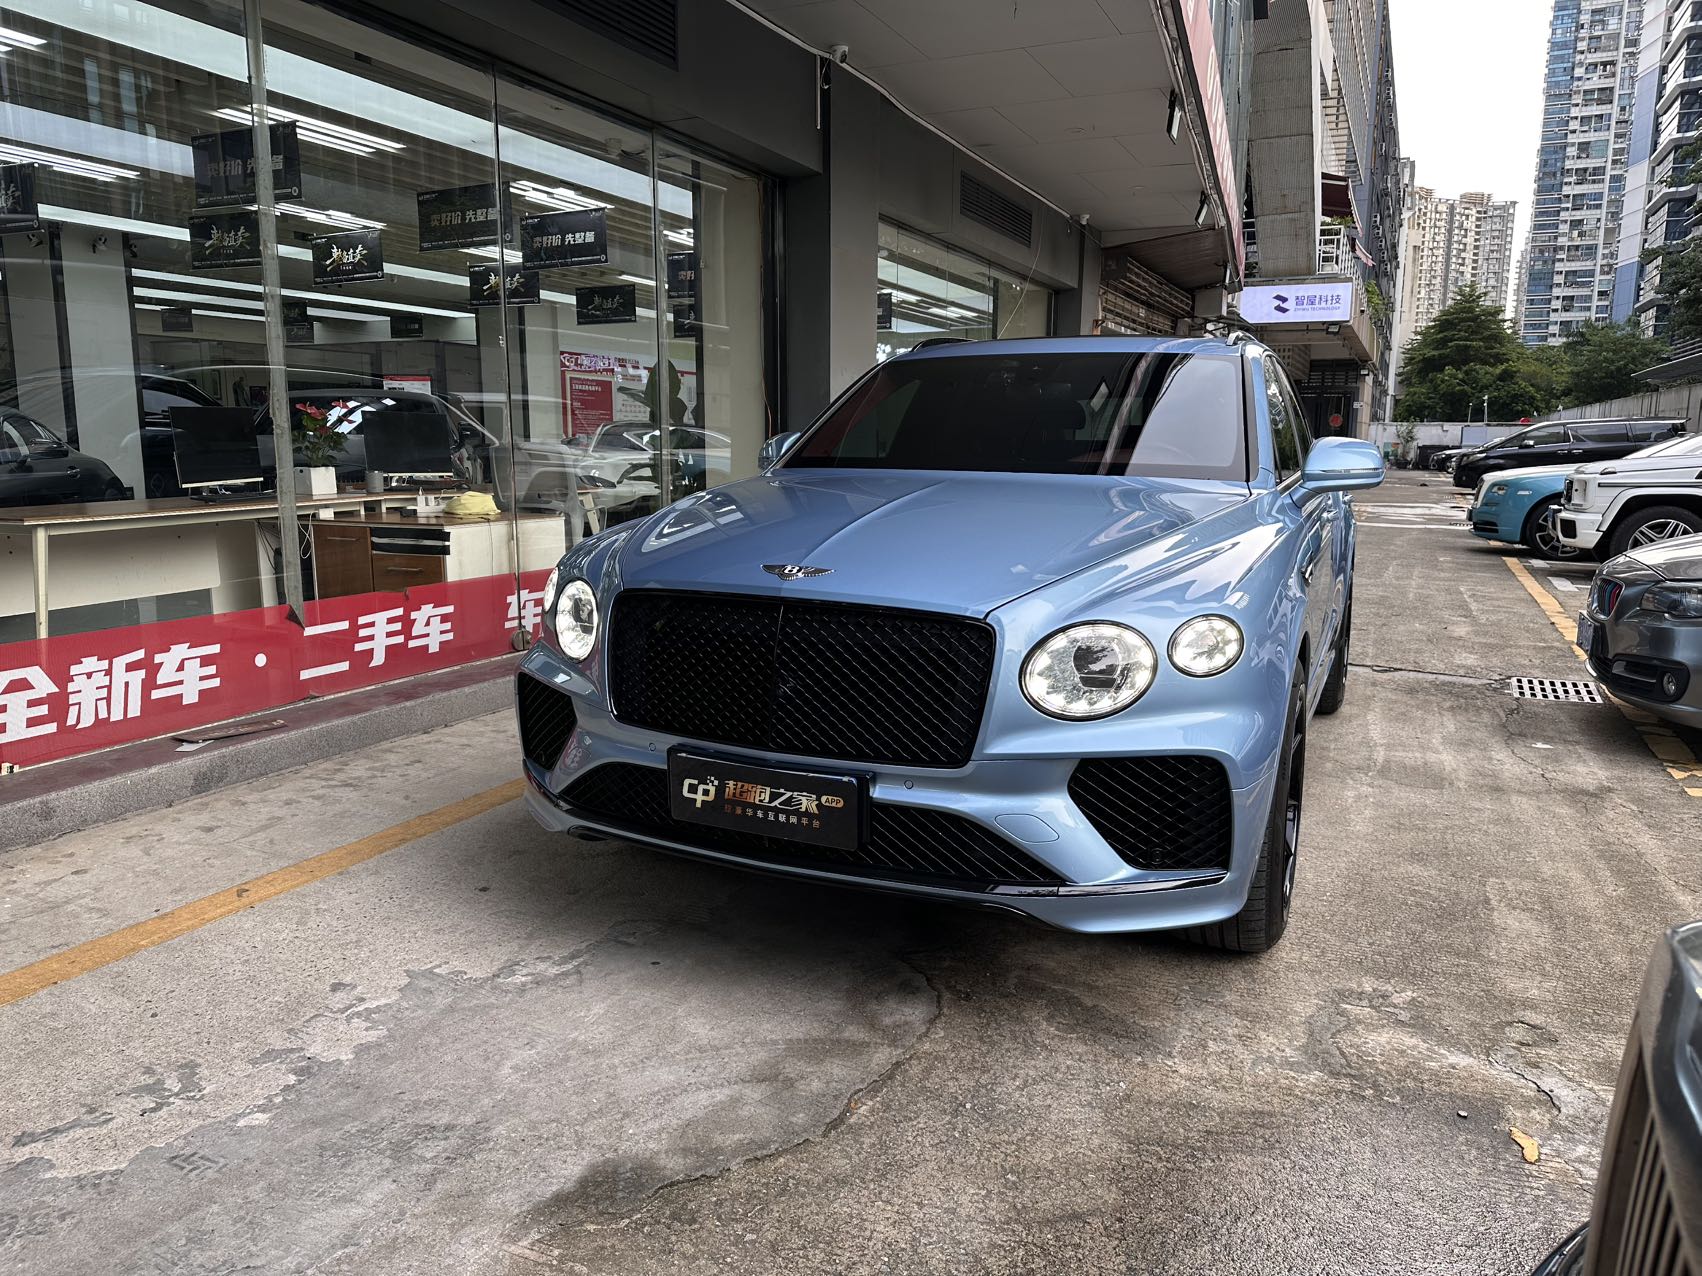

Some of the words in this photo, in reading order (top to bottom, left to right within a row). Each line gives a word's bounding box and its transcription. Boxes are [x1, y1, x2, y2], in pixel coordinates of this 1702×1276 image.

[430, 211, 462, 227] 卖好价
[465, 207, 499, 223] 先整备
[533, 234, 562, 249] 卖好价
[564, 231, 595, 246] 先整备
[1294, 294, 1342, 306] 智屋科技
[823, 796, 842, 807] APP
